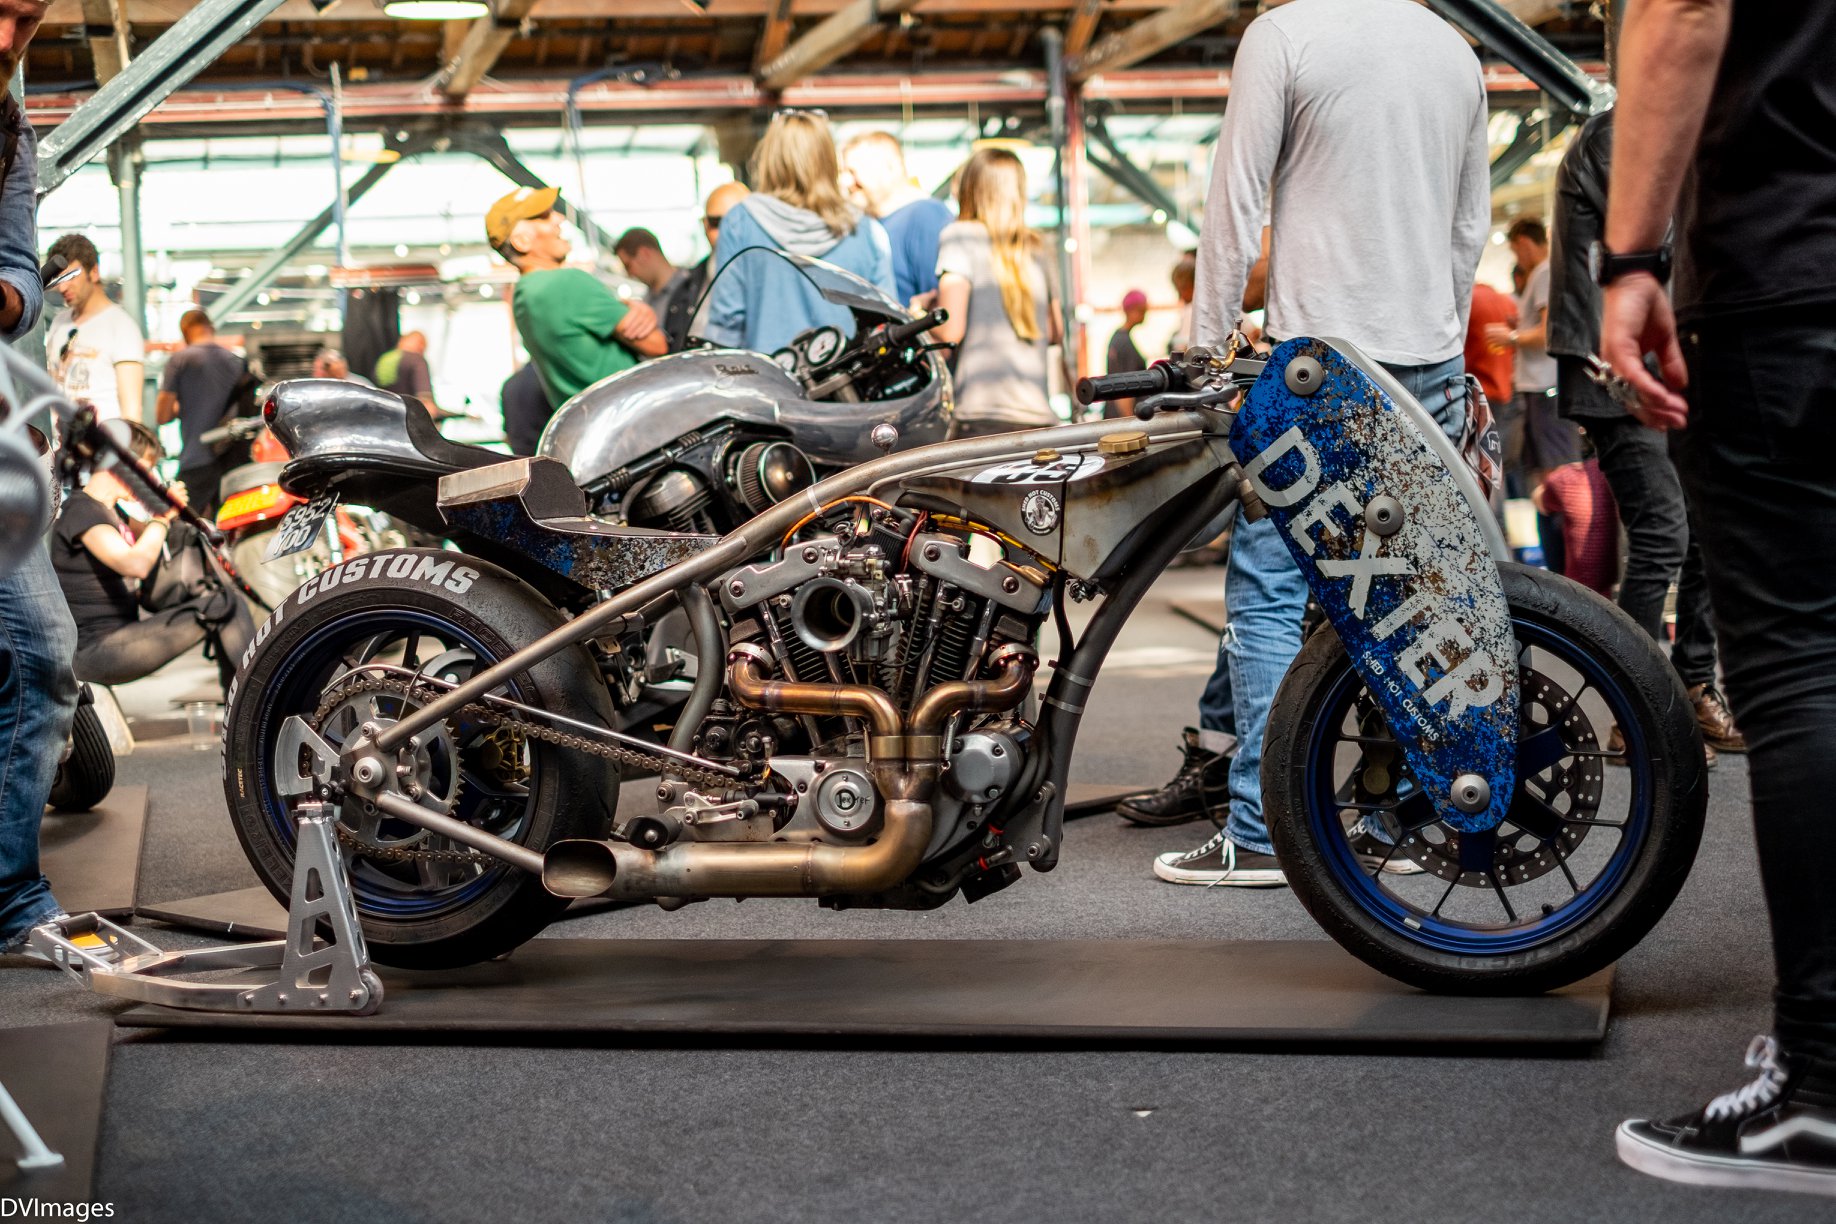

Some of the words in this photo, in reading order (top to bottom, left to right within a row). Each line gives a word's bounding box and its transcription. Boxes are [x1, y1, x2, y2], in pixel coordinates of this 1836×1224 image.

[297, 553, 480, 605] CUSTOMS
[1244, 426, 1501, 720] DEXTER
[1362, 650, 1385, 675] SHED
[1384, 676, 1404, 697] HOT
[1402, 698, 1440, 741] CUSTOMS
